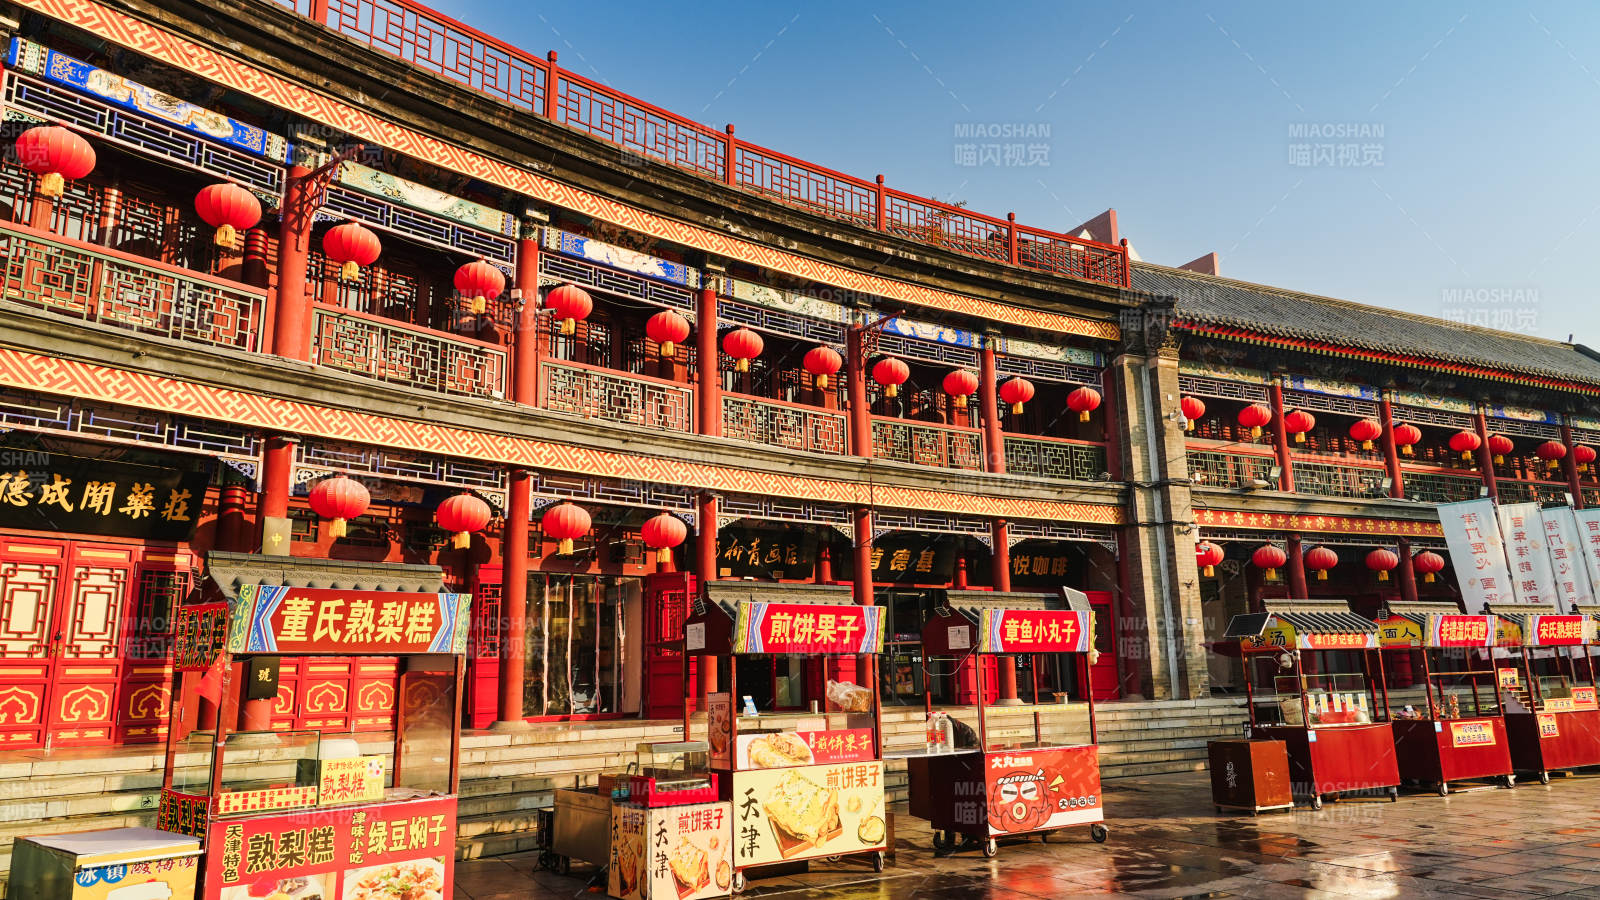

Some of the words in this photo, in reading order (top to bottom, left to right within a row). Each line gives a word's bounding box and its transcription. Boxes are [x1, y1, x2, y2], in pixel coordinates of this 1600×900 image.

[271, 532, 283, 547] 中
[871, 548, 936, 573] 肯德基
[1008, 555, 1069, 577] 悦咖啡
[277, 596, 436, 644] 董氏熟梨糕
[768, 612, 859, 645] 煎饼果子
[1004, 617, 1076, 644] 章鱼小丸子
[1441, 621, 1486, 641] 非遗温氏面塑
[1540, 621, 1582, 639] 宋氏熟梨糕
[1314, 633, 1363, 646] 津门罗记茶汤
[815, 734, 871, 757] 煎饼果子
[321, 771, 366, 801] 熟梨糕
[826, 765, 880, 792] 煎饼果子
[367, 814, 447, 855] 绿豆焖子
[622, 811, 645, 836] 煎饼果子
[678, 807, 724, 835] 煎饼果子
[741, 788, 760, 858] 天津
[247, 826, 335, 874] 熟梨糕
[349, 811, 367, 865] 津味小吃
[655, 819, 669, 879] 天津
[222, 824, 243, 883] 天津特色
